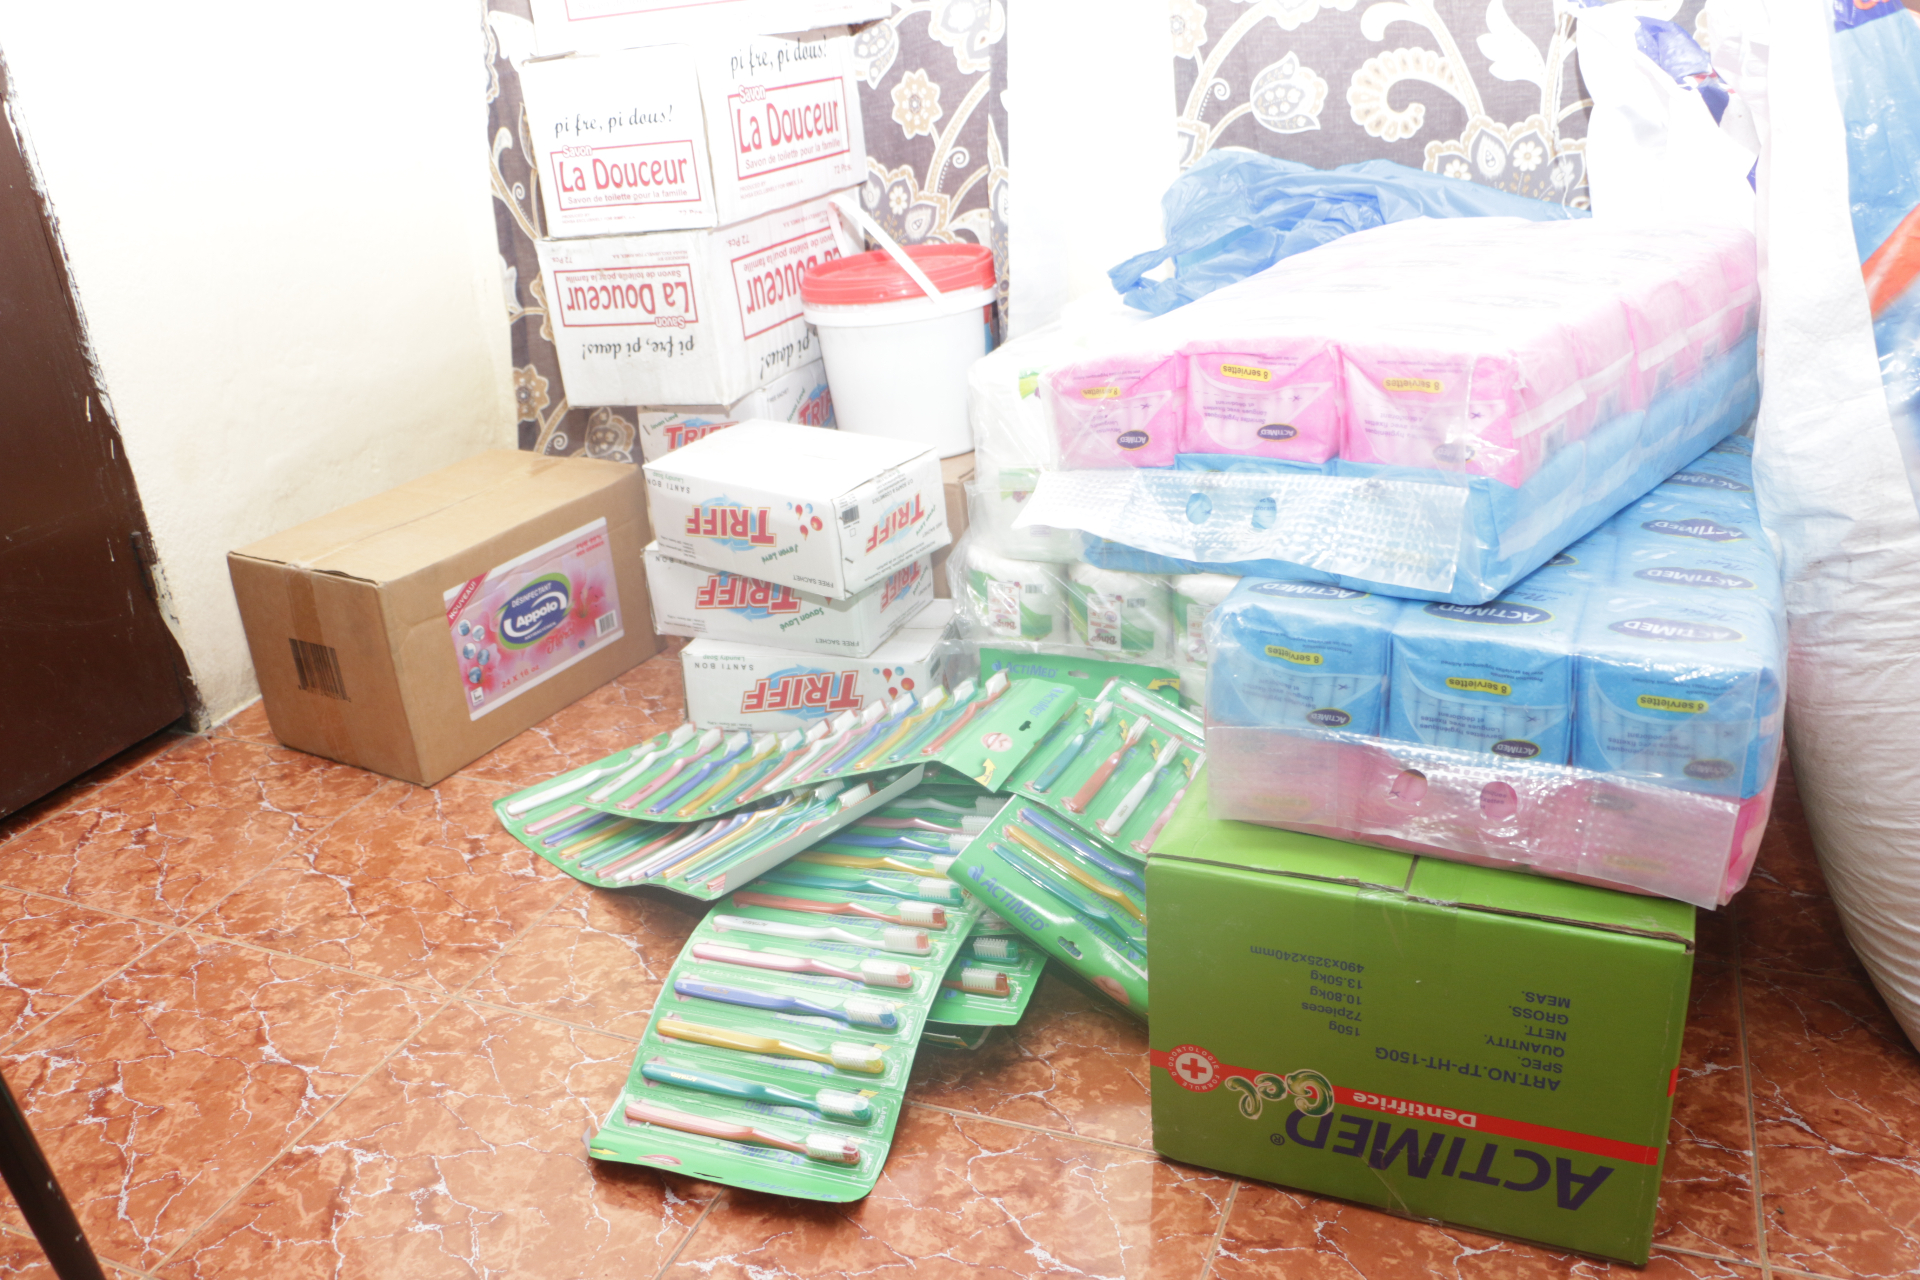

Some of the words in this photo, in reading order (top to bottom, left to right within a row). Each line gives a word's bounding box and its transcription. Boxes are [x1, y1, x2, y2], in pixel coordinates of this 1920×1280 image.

[731, 49, 744, 79] pi
[749, 44, 774, 76] fre,
[777, 42, 790, 72] pi
[794, 34, 827, 62] dous!
[738, 85, 766, 104] Savon
[554, 117, 570, 139] pi
[575, 113, 603, 137] fre,
[608, 111, 623, 133] pi
[628, 104, 673, 127] dous!
[737, 109, 762, 154] La
[766, 100, 839, 147] Douceur
[562, 145, 593, 158] Savon
[745, 155, 766, 170] Savon
[768, 154, 776, 164] de
[778, 148, 798, 162] toilette
[800, 146, 814, 158] pour
[815, 143, 821, 152] la
[821, 138, 841, 151] famille
[559, 161, 586, 193] La
[592, 158, 687, 190] Douceur
[568, 196, 592, 205] Savon
[593, 195, 603, 203] de
[604, 193, 631, 202] toilette
[633, 192, 651, 202] pour
[653, 189, 660, 198] la
[662, 188, 688, 197] famille
[740, 234, 750, 245] 72
[810, 239, 819, 249] de
[788, 243, 809, 255] toilette
[565, 274, 589, 283] famille
[646, 271, 656, 279] de
[658, 270, 681, 278] Savon
[567, 283, 656, 315] Douceur
[662, 281, 690, 313] La
[655, 315, 686, 329] Savon
[582, 343, 621, 361] dous!
[627, 336, 642, 358] pi
[646, 335, 674, 358] fre,
[678, 335, 695, 356] pi
[798, 328, 810, 359] pi
[760, 343, 794, 380] dous!
[1222, 365, 1262, 377] serviettes
[1263, 370, 1269, 379] 8
[1385, 379, 1431, 389] serviettes
[1434, 380, 1440, 391] 8
[1260, 429, 1294, 437] ACTIMED
[664, 473, 684, 483] Laundry
[1672, 473, 1743, 490] ACTIME
[666, 482, 691, 494] SANTI
[685, 505, 777, 547] TRIFF
[864, 490, 925, 557] TRIFF
[1654, 520, 1744, 538] ACTIMED
[793, 575, 817, 587] SACHET
[818, 578, 834, 588] FREE
[1647, 569, 1744, 588] ACTIMED
[695, 573, 802, 615] TRIFF
[1262, 583, 1357, 599] ACTIMED
[449, 581, 477, 620] NOUVEAU!
[516, 600, 558, 629] Appolo
[800, 606, 825, 623] Savon
[1624, 620, 1732, 641] ACTIMED
[815, 637, 840, 647] SACHET
[841, 639, 860, 647] FREE
[702, 653, 719, 661] Soap
[720, 655, 746, 663] Laundry
[1267, 645, 1311, 662] serviettes
[1313, 655, 1320, 664] 8
[694, 661, 715, 669] BON
[721, 663, 754, 671] SANTI
[1006, 661, 1057, 678] ACTIMED
[502, 678, 511, 689] 24
[740, 670, 864, 714] TRIFF
[1448, 677, 1499, 691] serviettes
[1501, 686, 1508, 694] 8
[1029, 691, 1060, 717] ACTIMED
[1640, 696, 1695, 710] serviettes
[1311, 713, 1346, 724] ACTIMED
[1449, 720, 1466, 728] avec
[1469, 723, 1500, 733] Longues
[1497, 743, 1535, 755] ACTIMED
[1103, 873, 1146, 903] CTIMED
[981, 877, 1045, 931] ACTIMED
[1075, 914, 1129, 954] ACTIMED
[809, 940, 870, 957] ACTIMED
[1250, 945, 1364, 974] 490x325x240mm
[1310, 969, 1363, 990] 13.50kg
[1309, 986, 1362, 1005] 10.80kg
[1521, 990, 1571, 1009] MEAS.
[1302, 1001, 1362, 1022] 72pieces
[1508, 1005, 1569, 1025] GROSS.
[903, 1015, 915, 1040] LARGE
[1328, 1020, 1361, 1037] 150g
[1523, 1025, 1567, 1042] NETT.
[1483, 1033, 1565, 1057] QUANTITY.
[1168, 1046, 1220, 1076] D'ODONTOLOGIE
[1375, 1046, 1561, 1091] ART.NO.TP-HT-150G
[1517, 1056, 1563, 1074] SPEC.
[890, 1060, 901, 1081] LARGE
[1182, 1073, 1220, 1091] FORMULE
[745, 1100, 807, 1121] ACTIMED
[877, 1106, 888, 1129] LARGE
[1352, 1091, 1476, 1128] Dentifrice
[727, 1142, 793, 1165] ACTIMED
[1284, 1108, 1615, 1211] ACTIMED
[862, 1153, 874, 1173] LARGE
